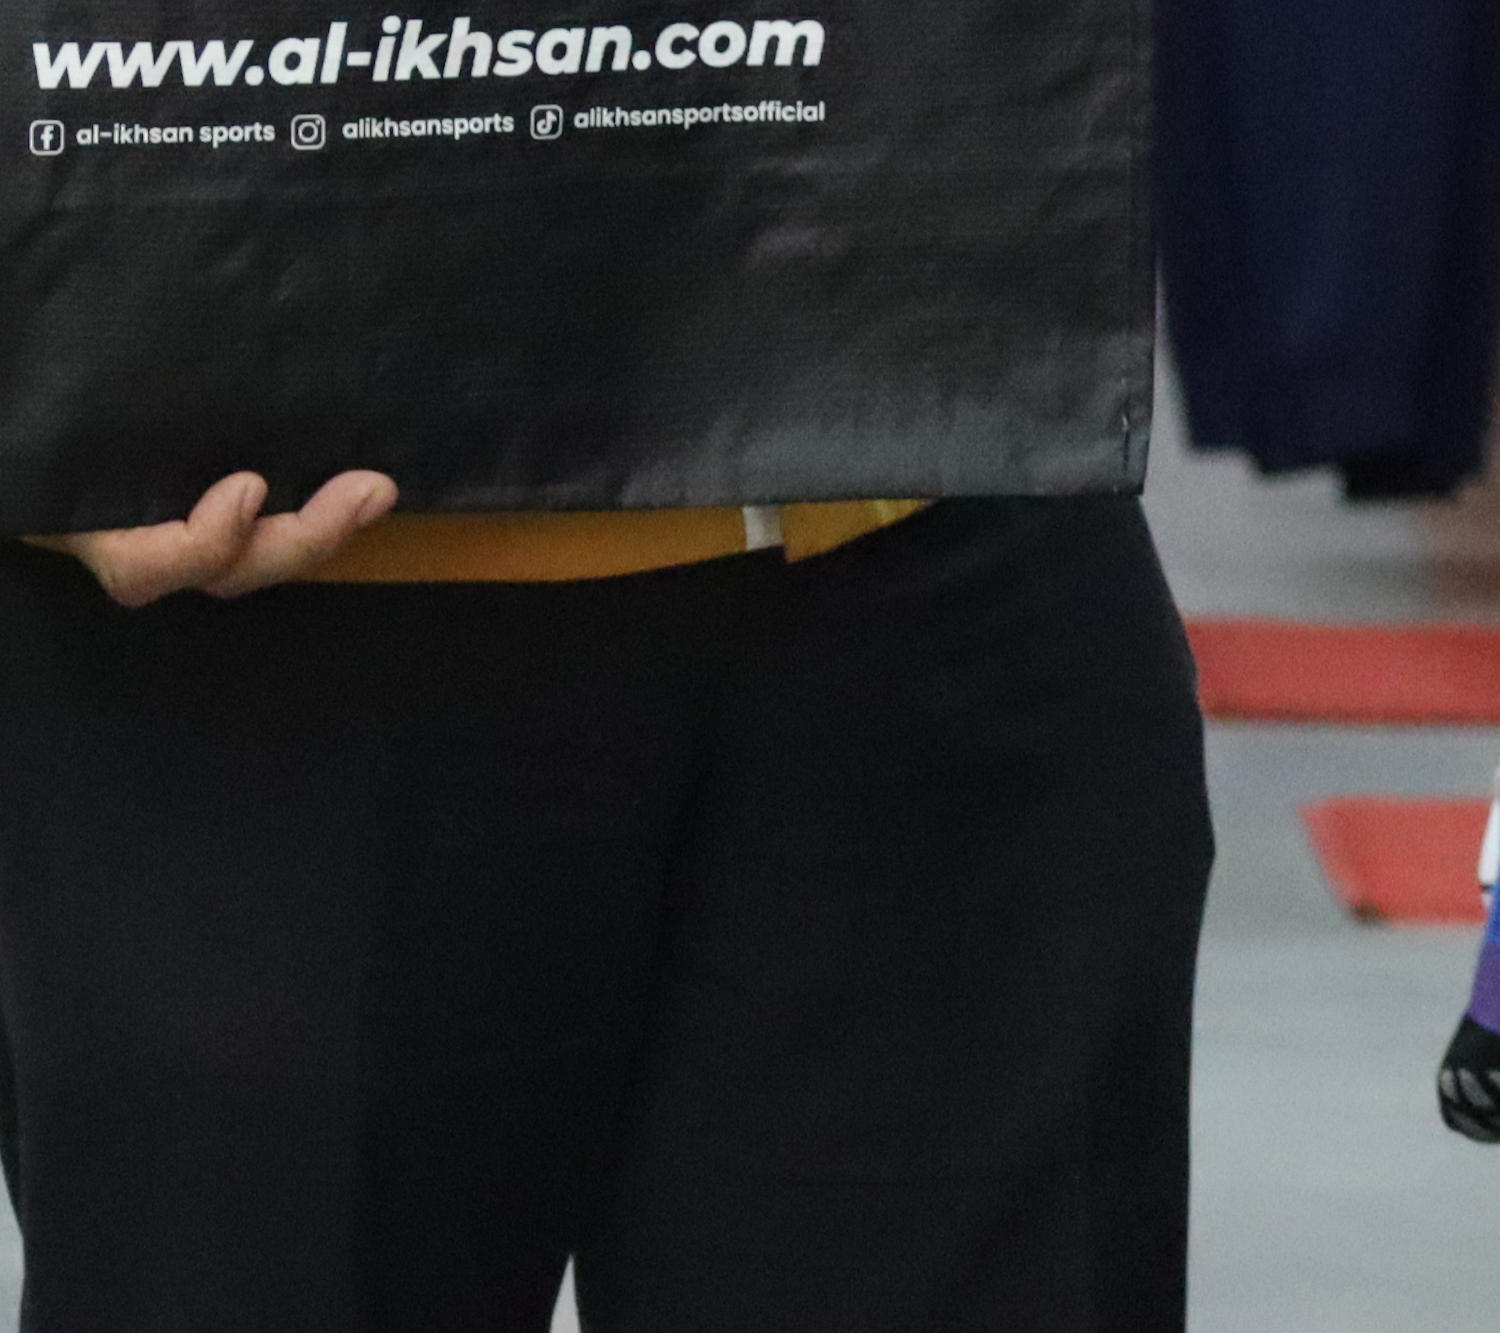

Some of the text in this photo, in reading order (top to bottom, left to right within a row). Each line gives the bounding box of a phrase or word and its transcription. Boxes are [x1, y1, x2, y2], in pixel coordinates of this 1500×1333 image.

[32, 16, 826, 90] www.al-ikhsan.com
[342, 113, 515, 141] alikhsansports
[574, 100, 826, 131] alikhsansportsofficial
[76, 120, 275, 149] al-ikhsan sports
